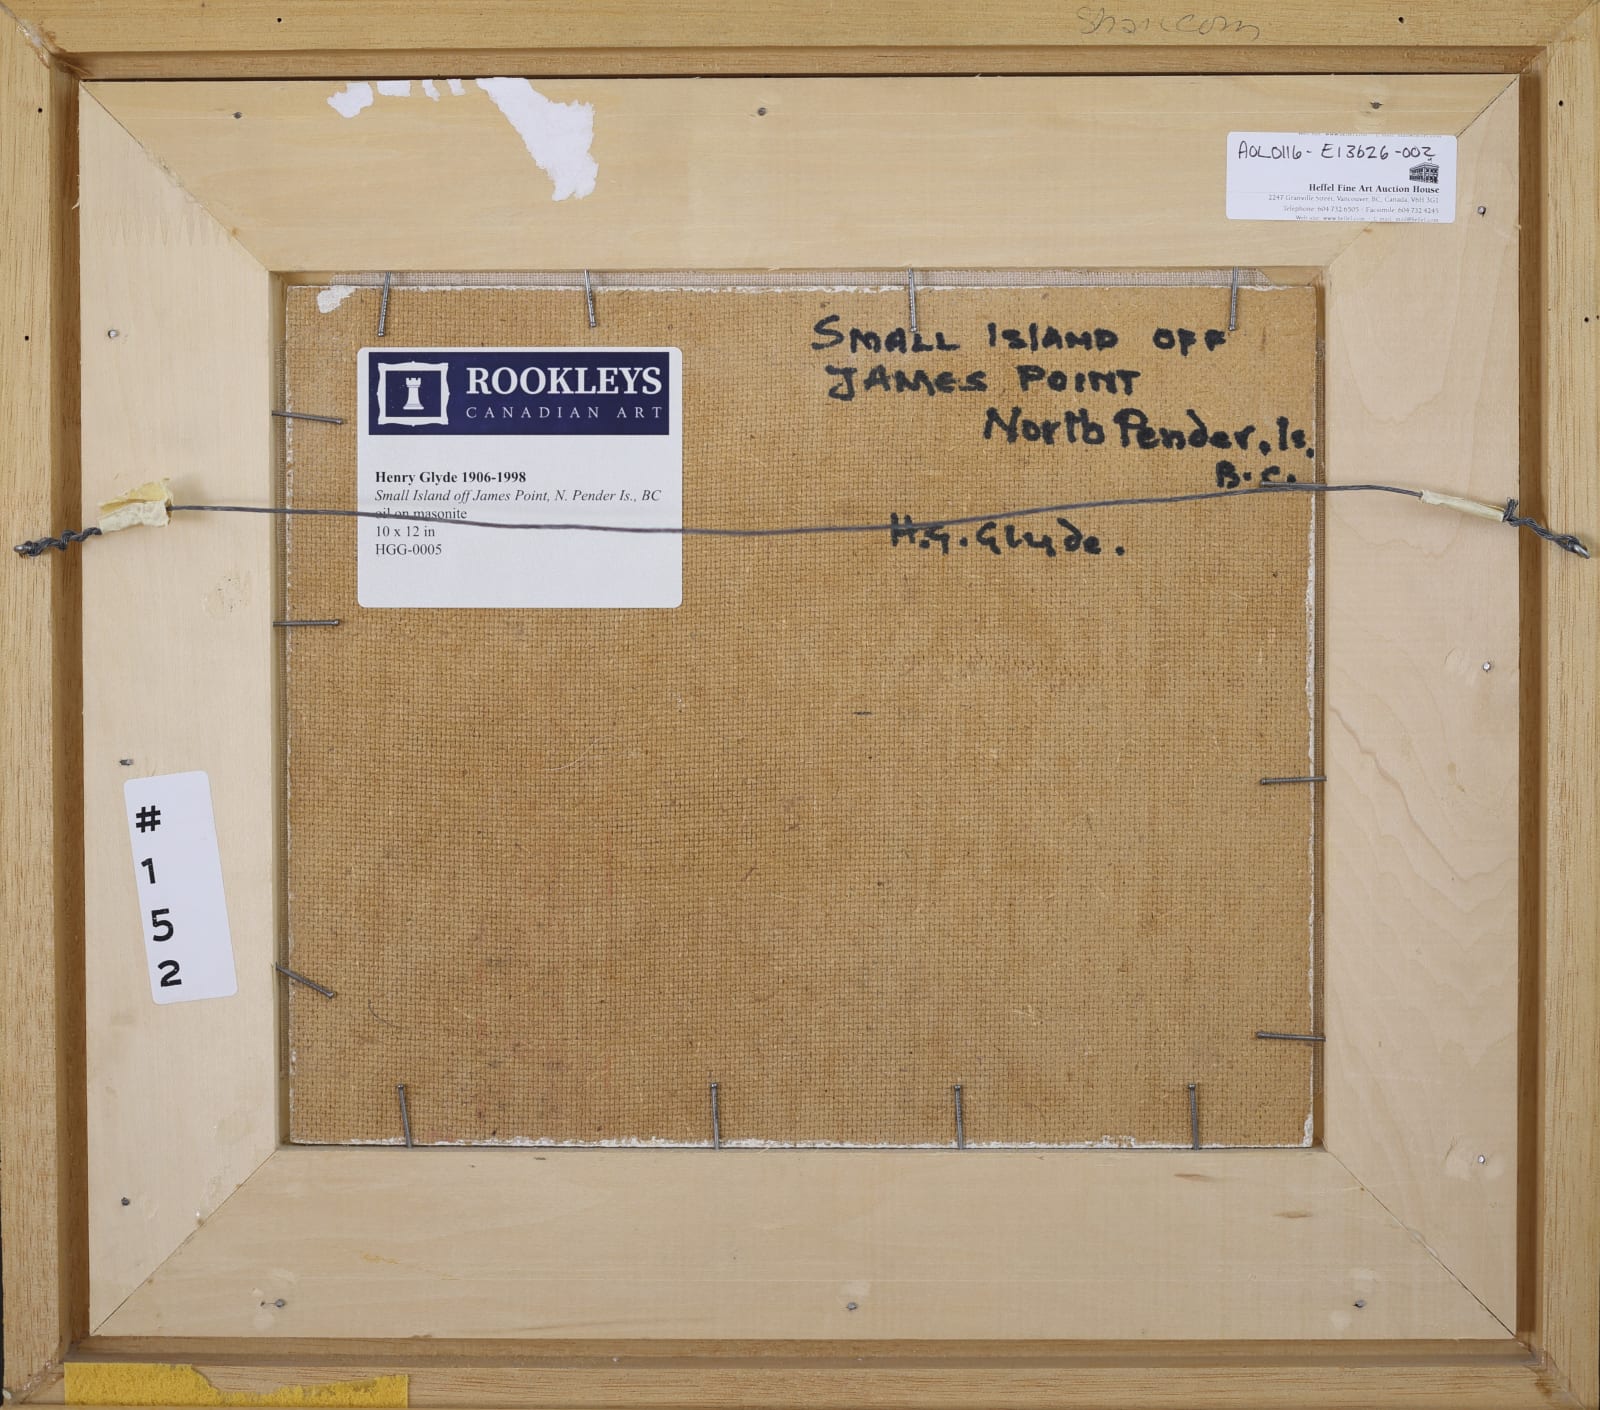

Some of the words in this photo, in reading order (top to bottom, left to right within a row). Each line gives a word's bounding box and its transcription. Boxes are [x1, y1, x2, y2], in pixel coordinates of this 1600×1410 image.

[1309, 183, 1335, 192] Heffel
[1337, 184, 1357, 192] Fine
[1359, 185, 1373, 193] Art
[1376, 185, 1410, 193] Auction
[1413, 185, 1440, 194] House
[810, 314, 961, 354] SMALL
[466, 366, 663, 396] ROOKLEYS
[825, 363, 989, 402] JAMES
[1017, 364, 1142, 396] POINT
[466, 406, 601, 420] CANADIAN
[616, 406, 663, 420] ART
[983, 406, 1105, 446] North
[375, 471, 416, 486] Henry
[419, 471, 458, 486] Glyde
[462, 471, 527, 483] 1906-1998
[375, 489, 410, 501] Small
[413, 489, 451, 501] Island
[453, 489, 473, 504] off
[472, 489, 511, 502] James
[514, 489, 551, 503] Point,
[554, 489, 568, 501] N.
[572, 489, 617, 501] Pender
[619, 489, 638, 503] Is.,
[641, 489, 662, 501] BC
[375, 507, 391, 520] oil
[394, 510, 410, 520] on
[413, 507, 468, 520] masonite
[375, 525, 391, 537] 10
[393, 528, 402, 537] x
[405, 525, 420, 537] 12
[423, 525, 436, 537] in
[375, 543, 443, 556] HGG-0005
